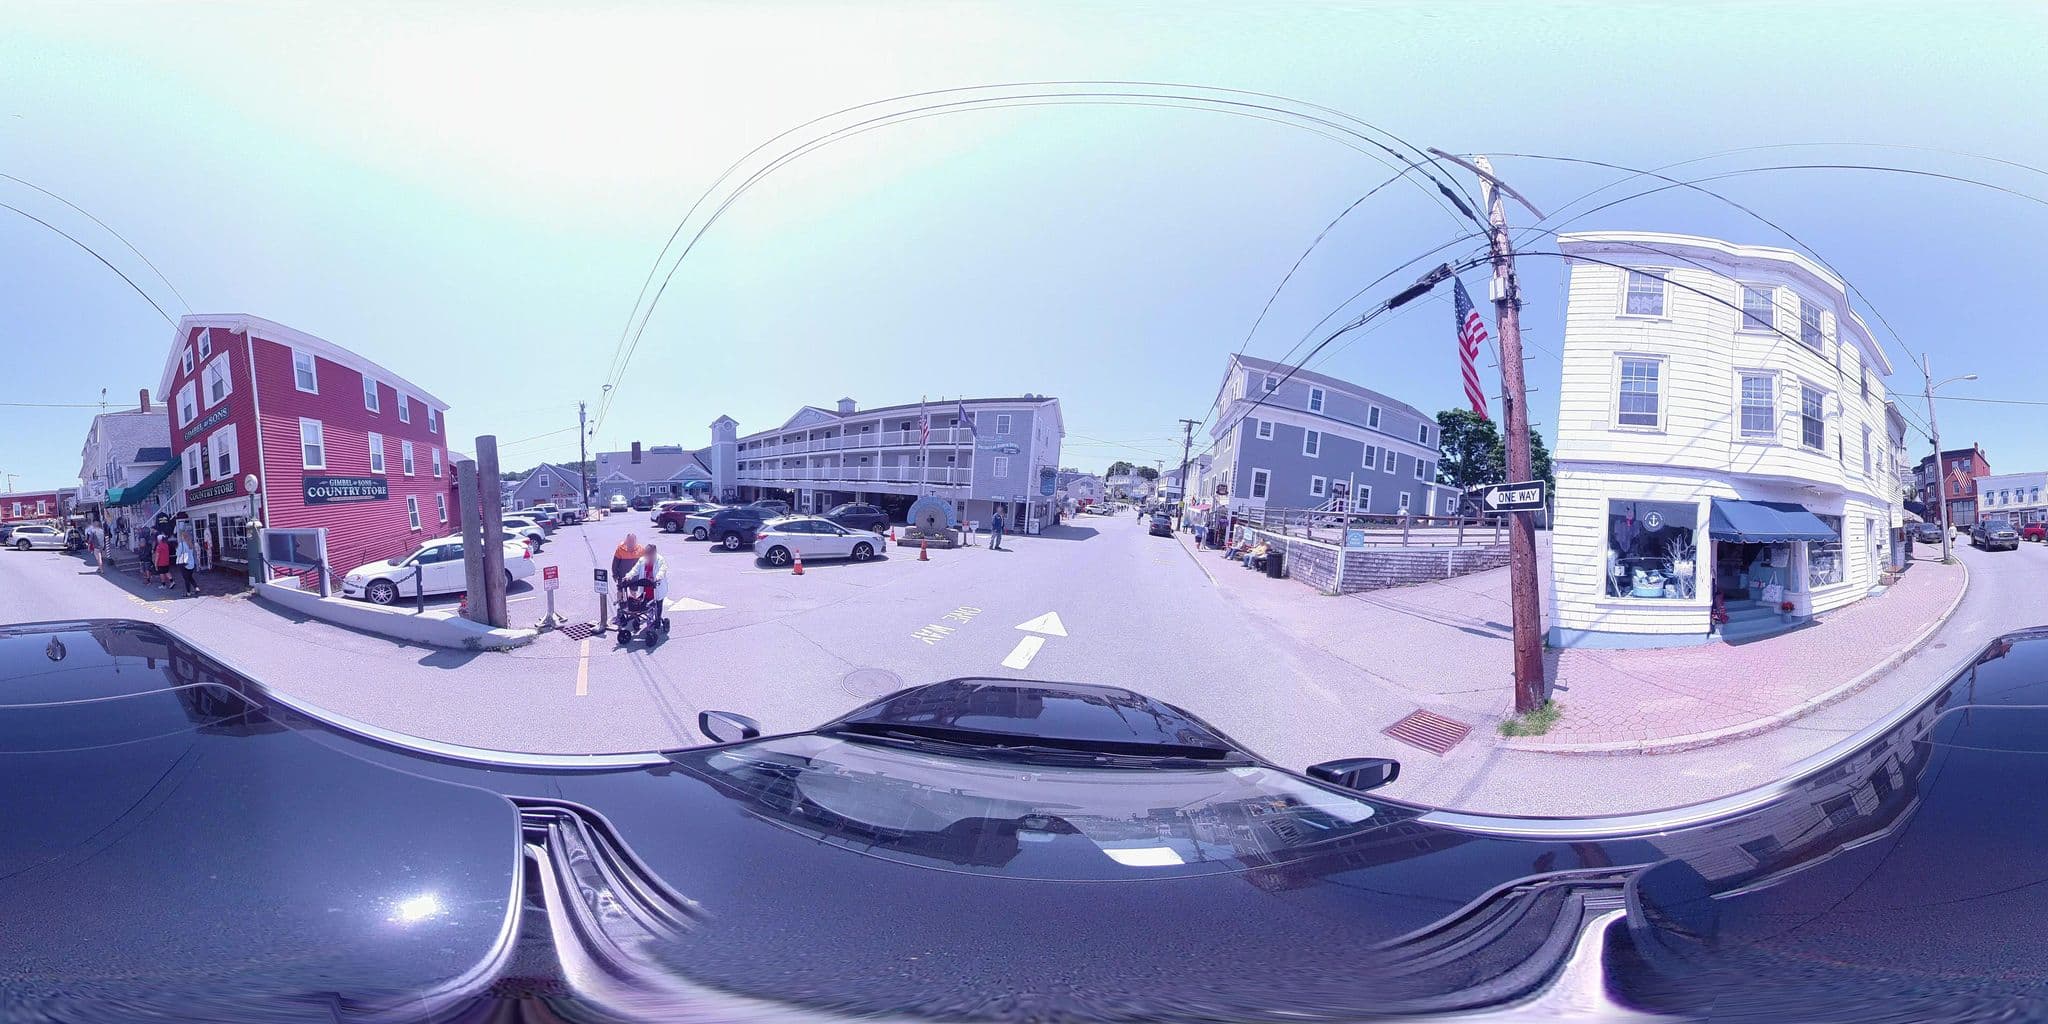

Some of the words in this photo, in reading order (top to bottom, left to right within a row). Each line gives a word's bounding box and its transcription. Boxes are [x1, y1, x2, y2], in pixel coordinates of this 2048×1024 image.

[208, 407, 228, 425] SONS
[189, 488, 214, 501] COUNTRY
[213, 482, 234, 496] STORE
[307, 486, 360, 497] COUNTRY
[361, 486, 387, 495] STORE
[1498, 492, 1517, 502] ONE
[1519, 490, 1537, 501] WAY
